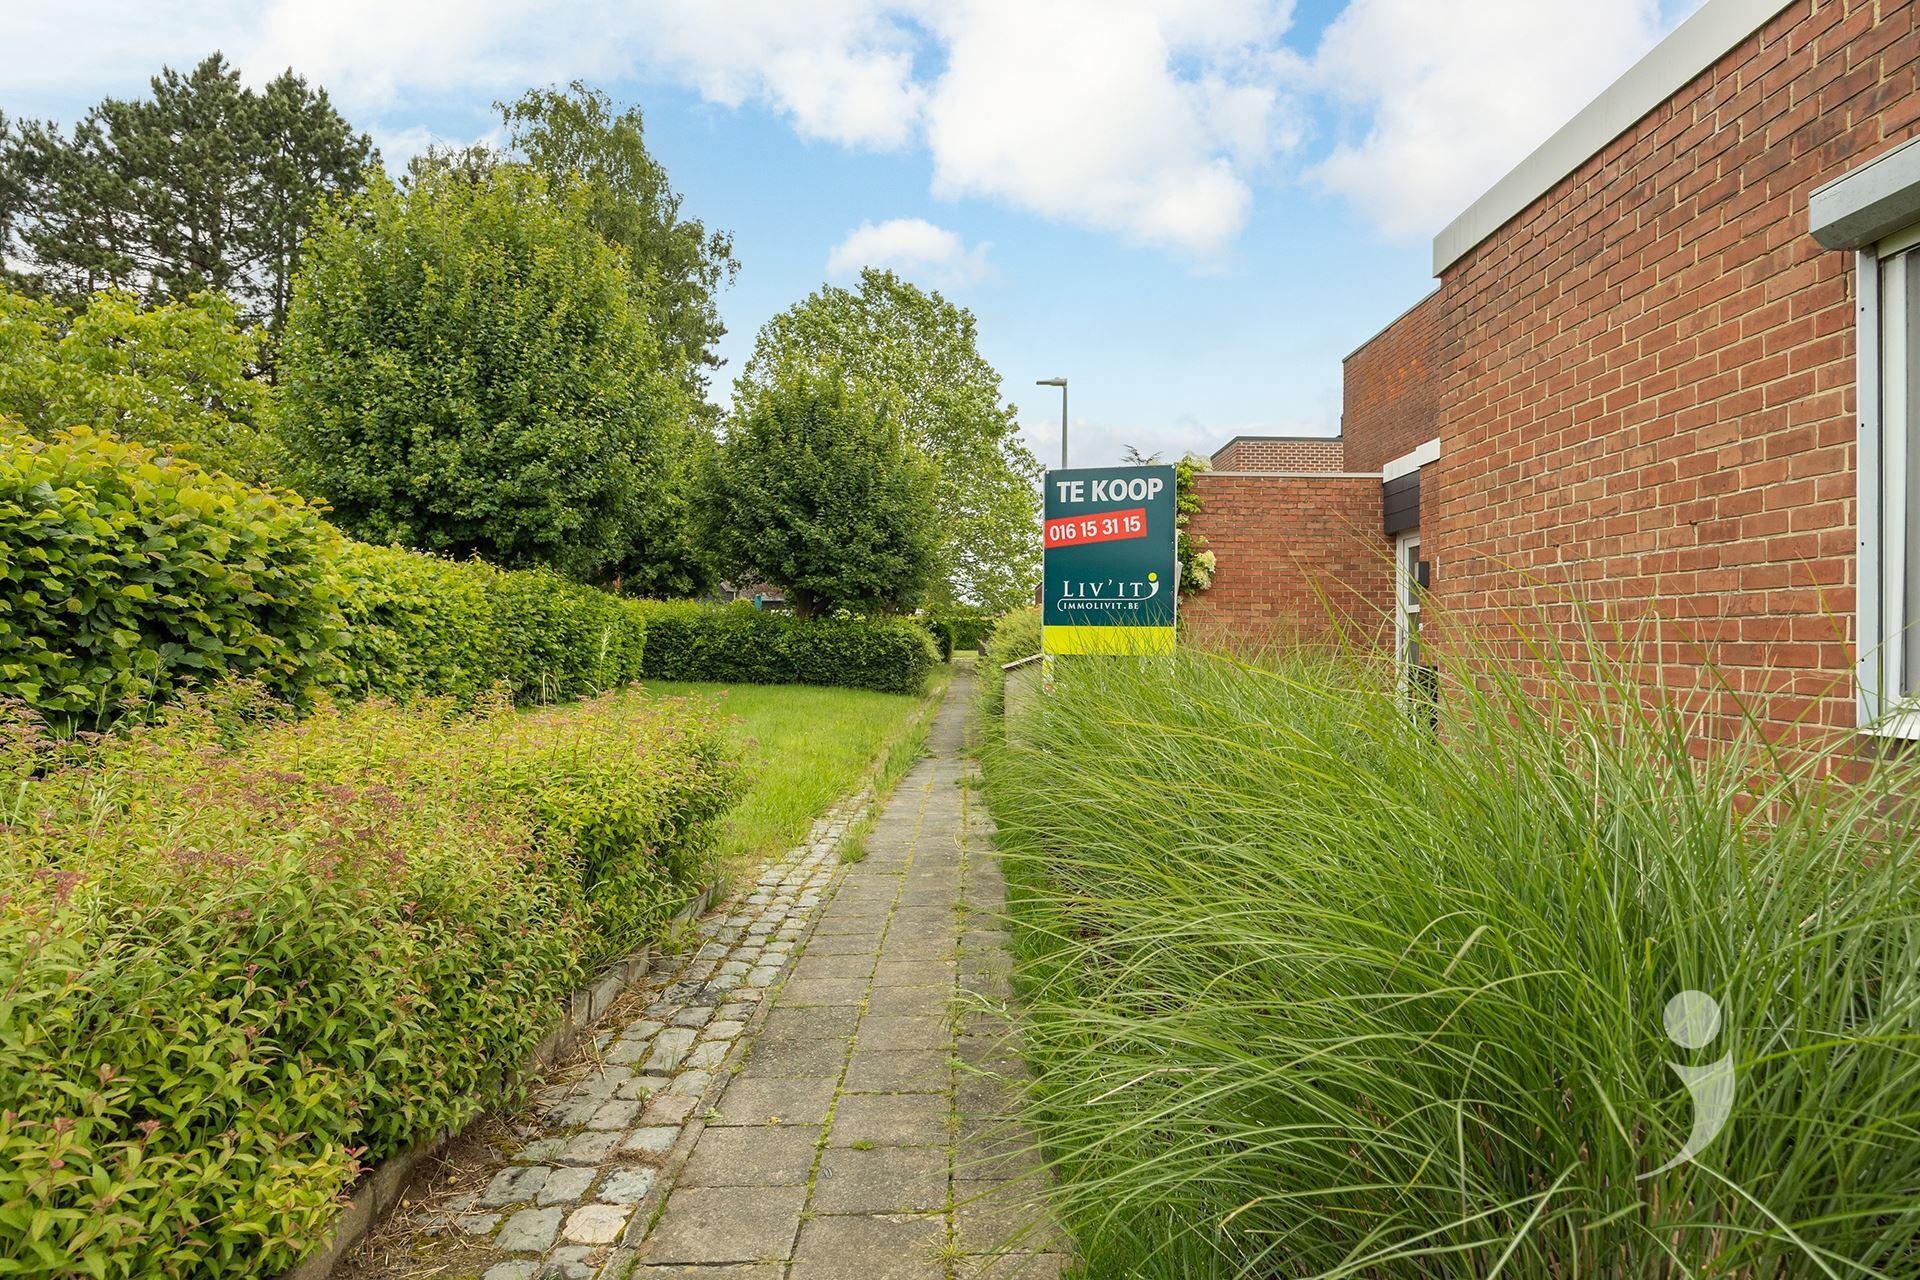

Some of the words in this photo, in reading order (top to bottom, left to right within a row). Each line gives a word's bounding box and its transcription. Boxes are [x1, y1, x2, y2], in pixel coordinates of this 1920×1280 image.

[1056, 480, 1084, 503] TE
[1091, 478, 1163, 502] KOOP
[1049, 523, 1077, 541] 016
[1080, 520, 1098, 538] 15
[1102, 517, 1119, 535] 31
[1123, 515, 1141, 533] 15
[1063, 602, 1140, 610] IMMOLIVIT.BE
